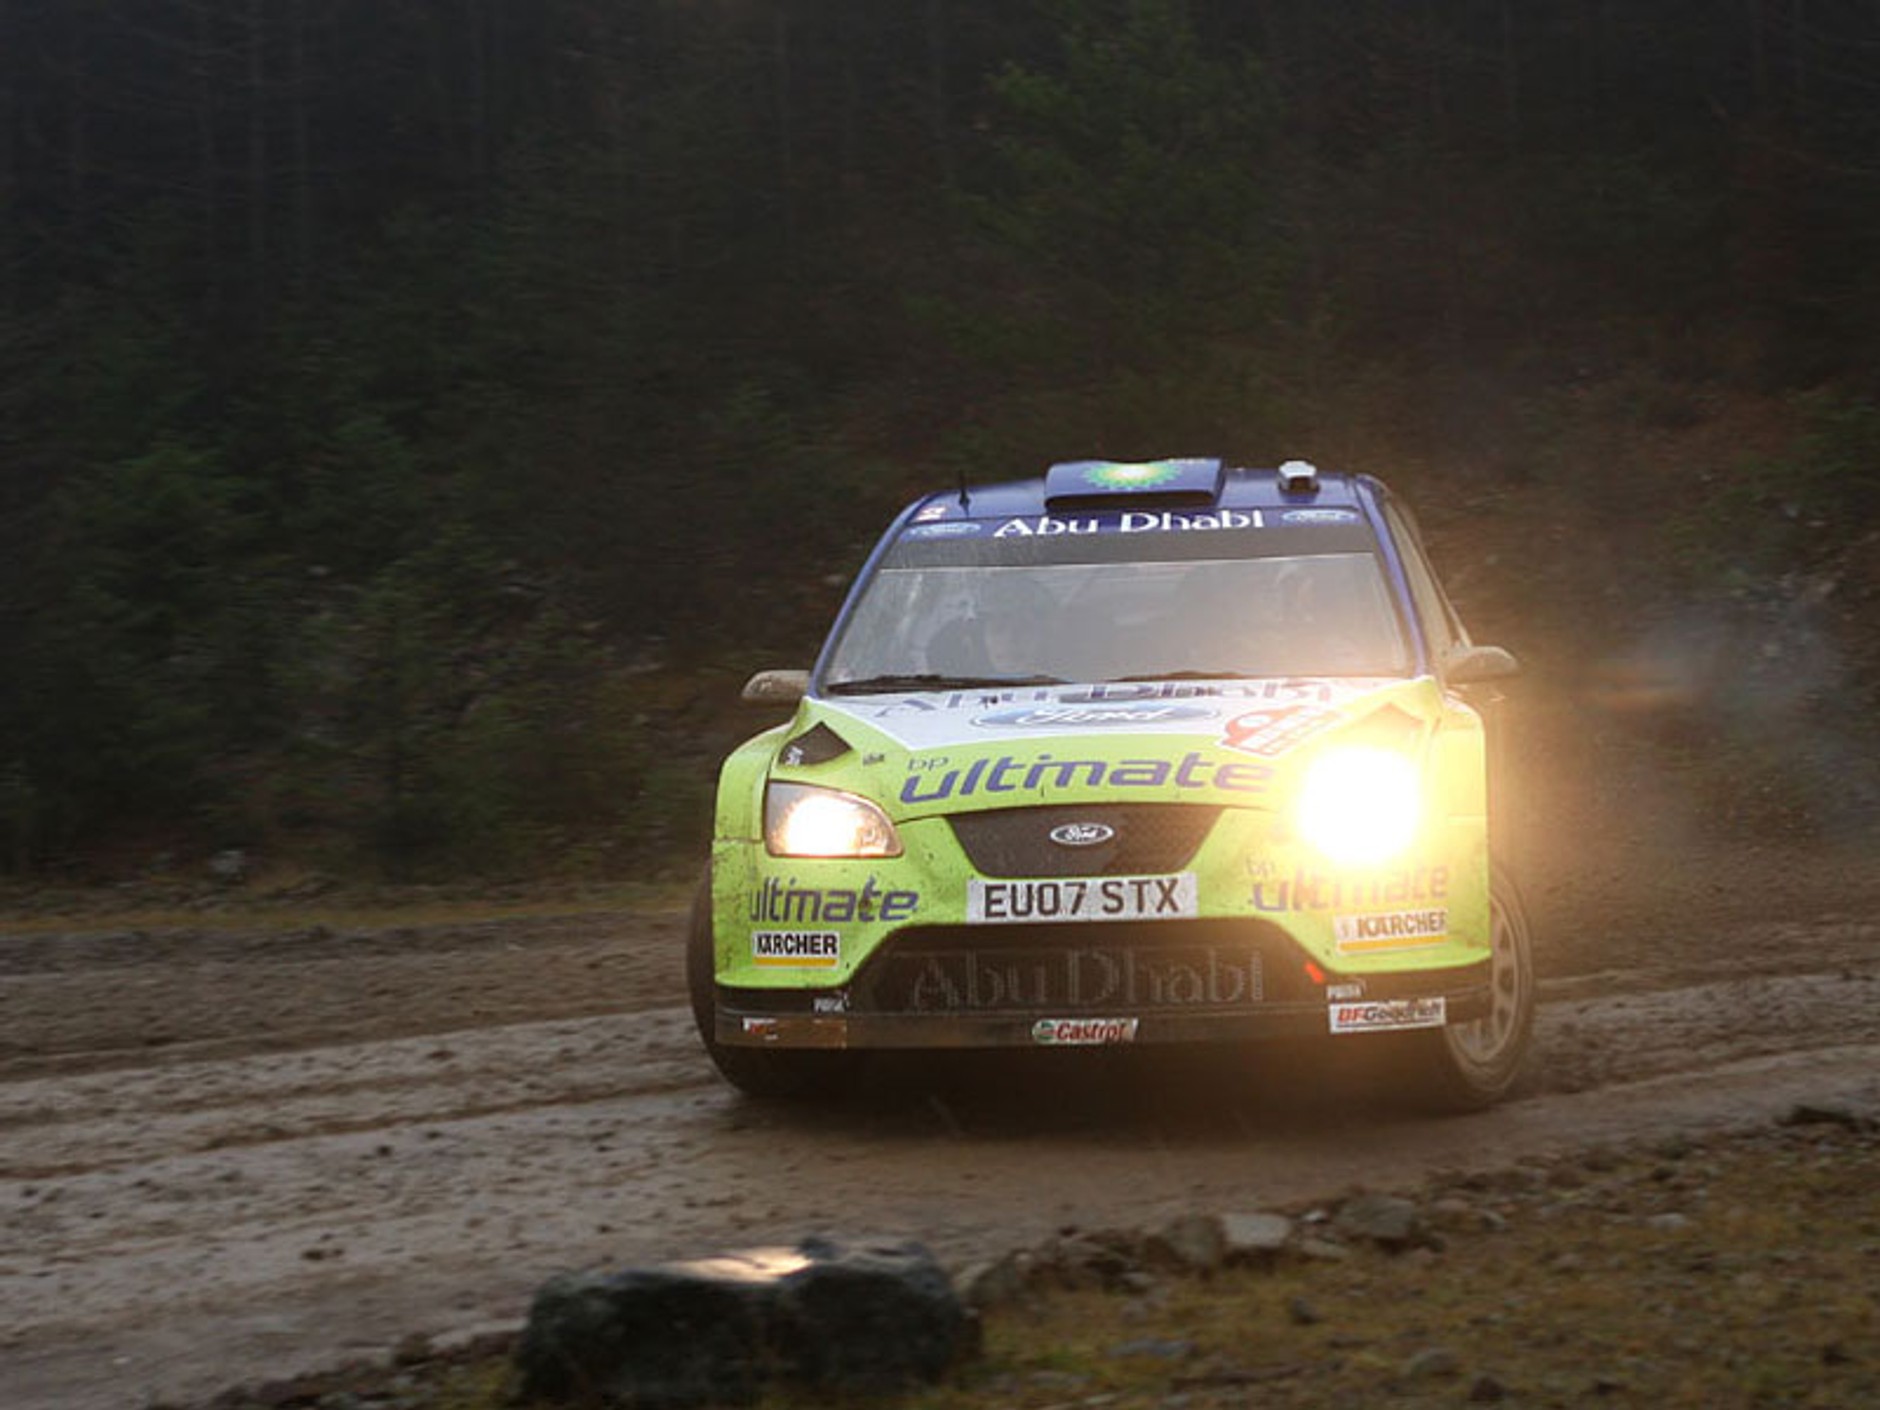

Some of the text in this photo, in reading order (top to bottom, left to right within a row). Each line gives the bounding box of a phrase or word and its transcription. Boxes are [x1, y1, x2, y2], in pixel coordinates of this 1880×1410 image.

[993, 515, 1098, 538] Abu
[1119, 510, 1264, 532] Dhabi
[899, 752, 1274, 804] ultimate
[749, 874, 920, 923] ultimate
[984, 878, 1180, 918] EU07 STX
[913, 947, 1263, 1006] Abu Dhabi
